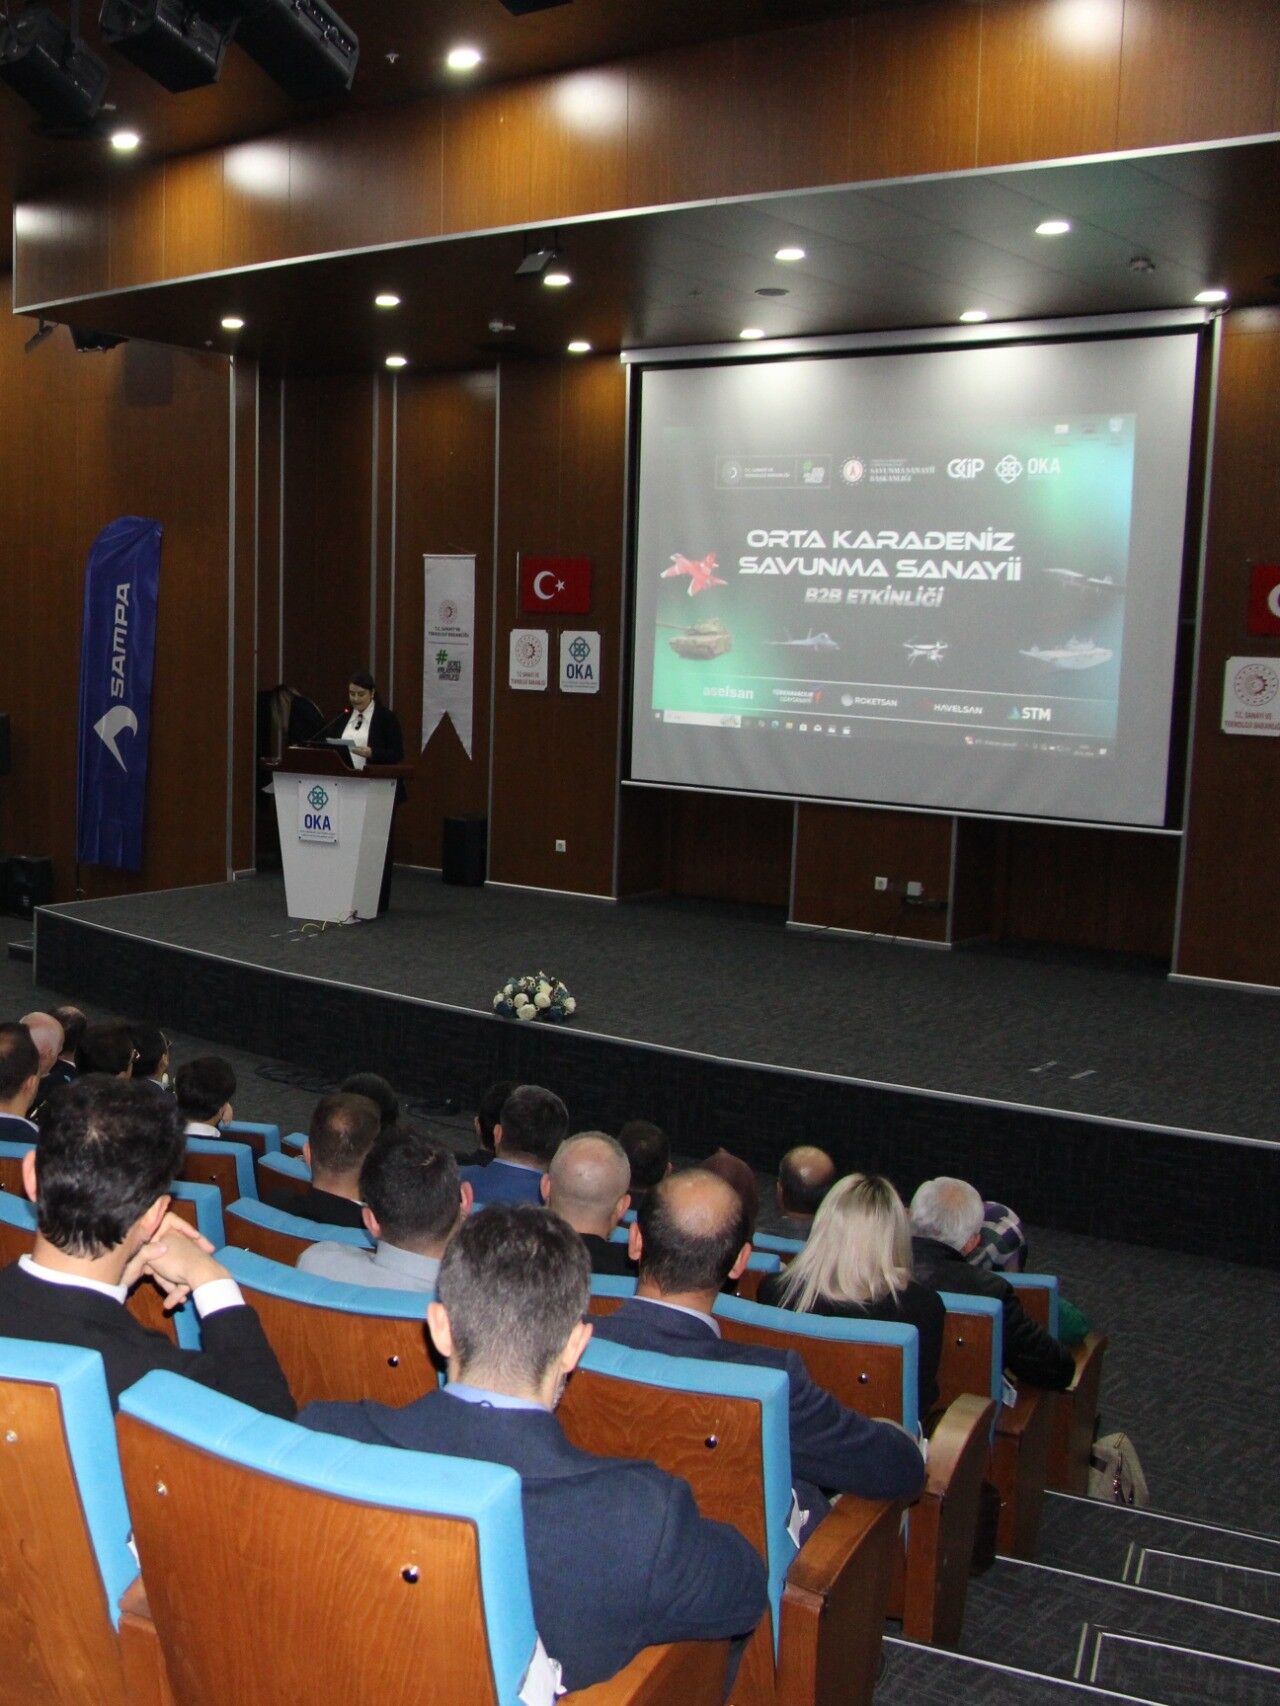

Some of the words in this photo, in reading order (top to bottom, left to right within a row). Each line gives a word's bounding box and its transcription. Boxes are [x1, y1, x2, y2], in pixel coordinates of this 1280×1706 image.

[1027, 457, 1061, 475] OKA
[746, 529, 827, 549] ORTA
[832, 526, 1016, 551] KARADENİZ
[738, 556, 889, 578] SAVUNMA
[895, 556, 1022, 582] SANAYİİ
[804, 587, 843, 604] B2B
[846, 585, 945, 608] ETKİNLİĞİ
[110, 582, 131, 699] SAMPA
[566, 663, 594, 681] OKA
[703, 685, 755, 700] aselsan
[854, 696, 898, 708] ROKETSAN
[933, 703, 983, 715] HAVELSAN
[1021, 706, 1052, 721] STM
[304, 813, 332, 831] OKA
